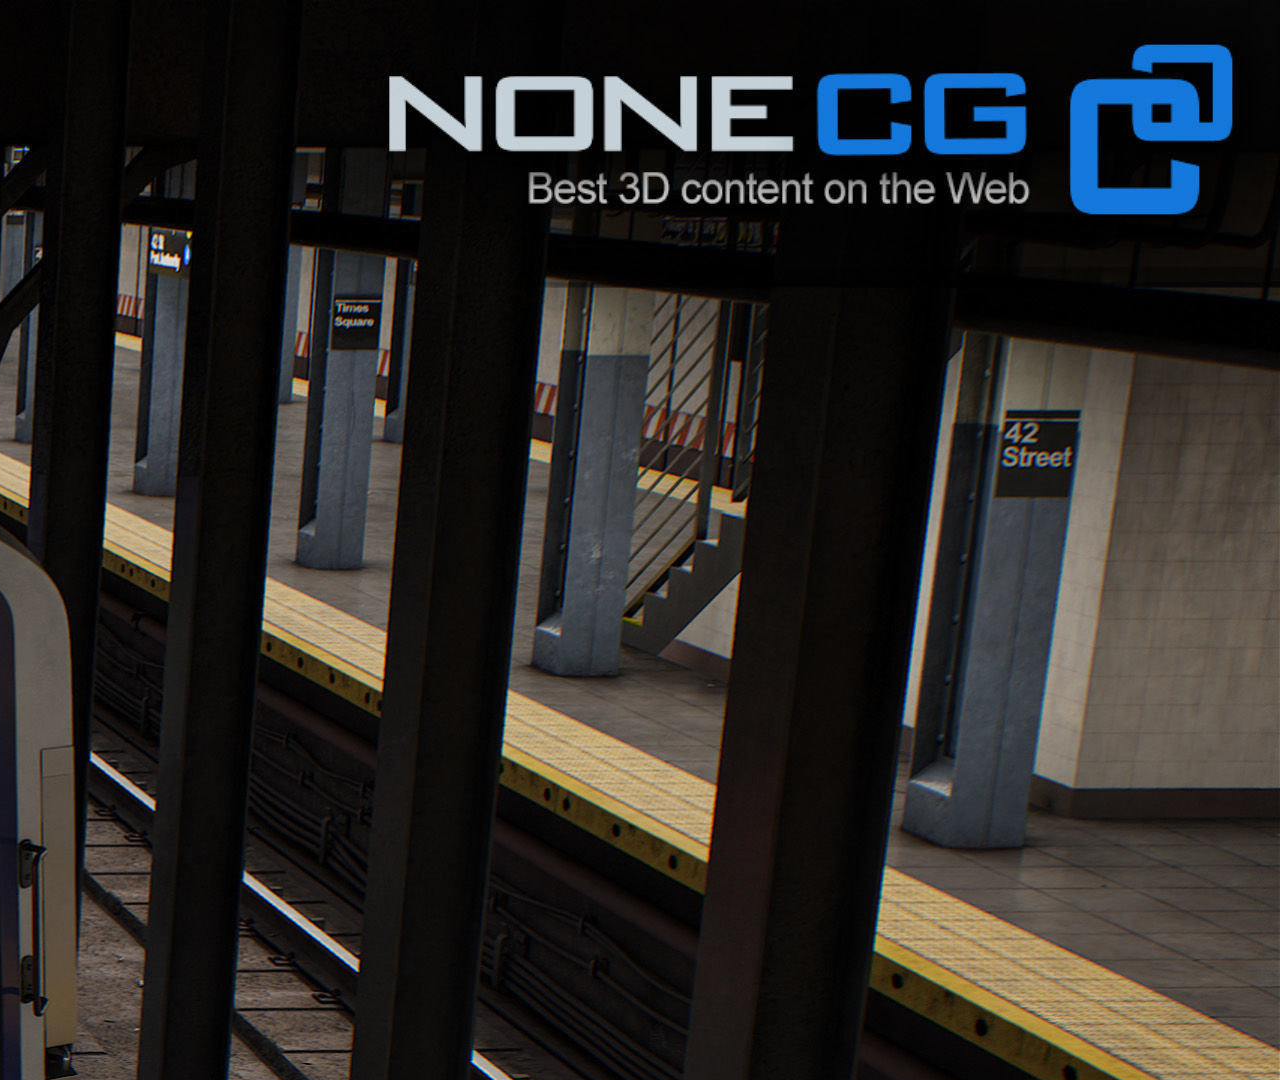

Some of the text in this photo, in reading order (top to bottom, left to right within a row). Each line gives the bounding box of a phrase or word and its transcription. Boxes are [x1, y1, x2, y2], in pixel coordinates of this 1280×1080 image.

[335, 303, 370, 314] Times
[334, 315, 375, 331] Square
[1003, 422, 1040, 444] 42
[1001, 445, 1074, 468] Street
